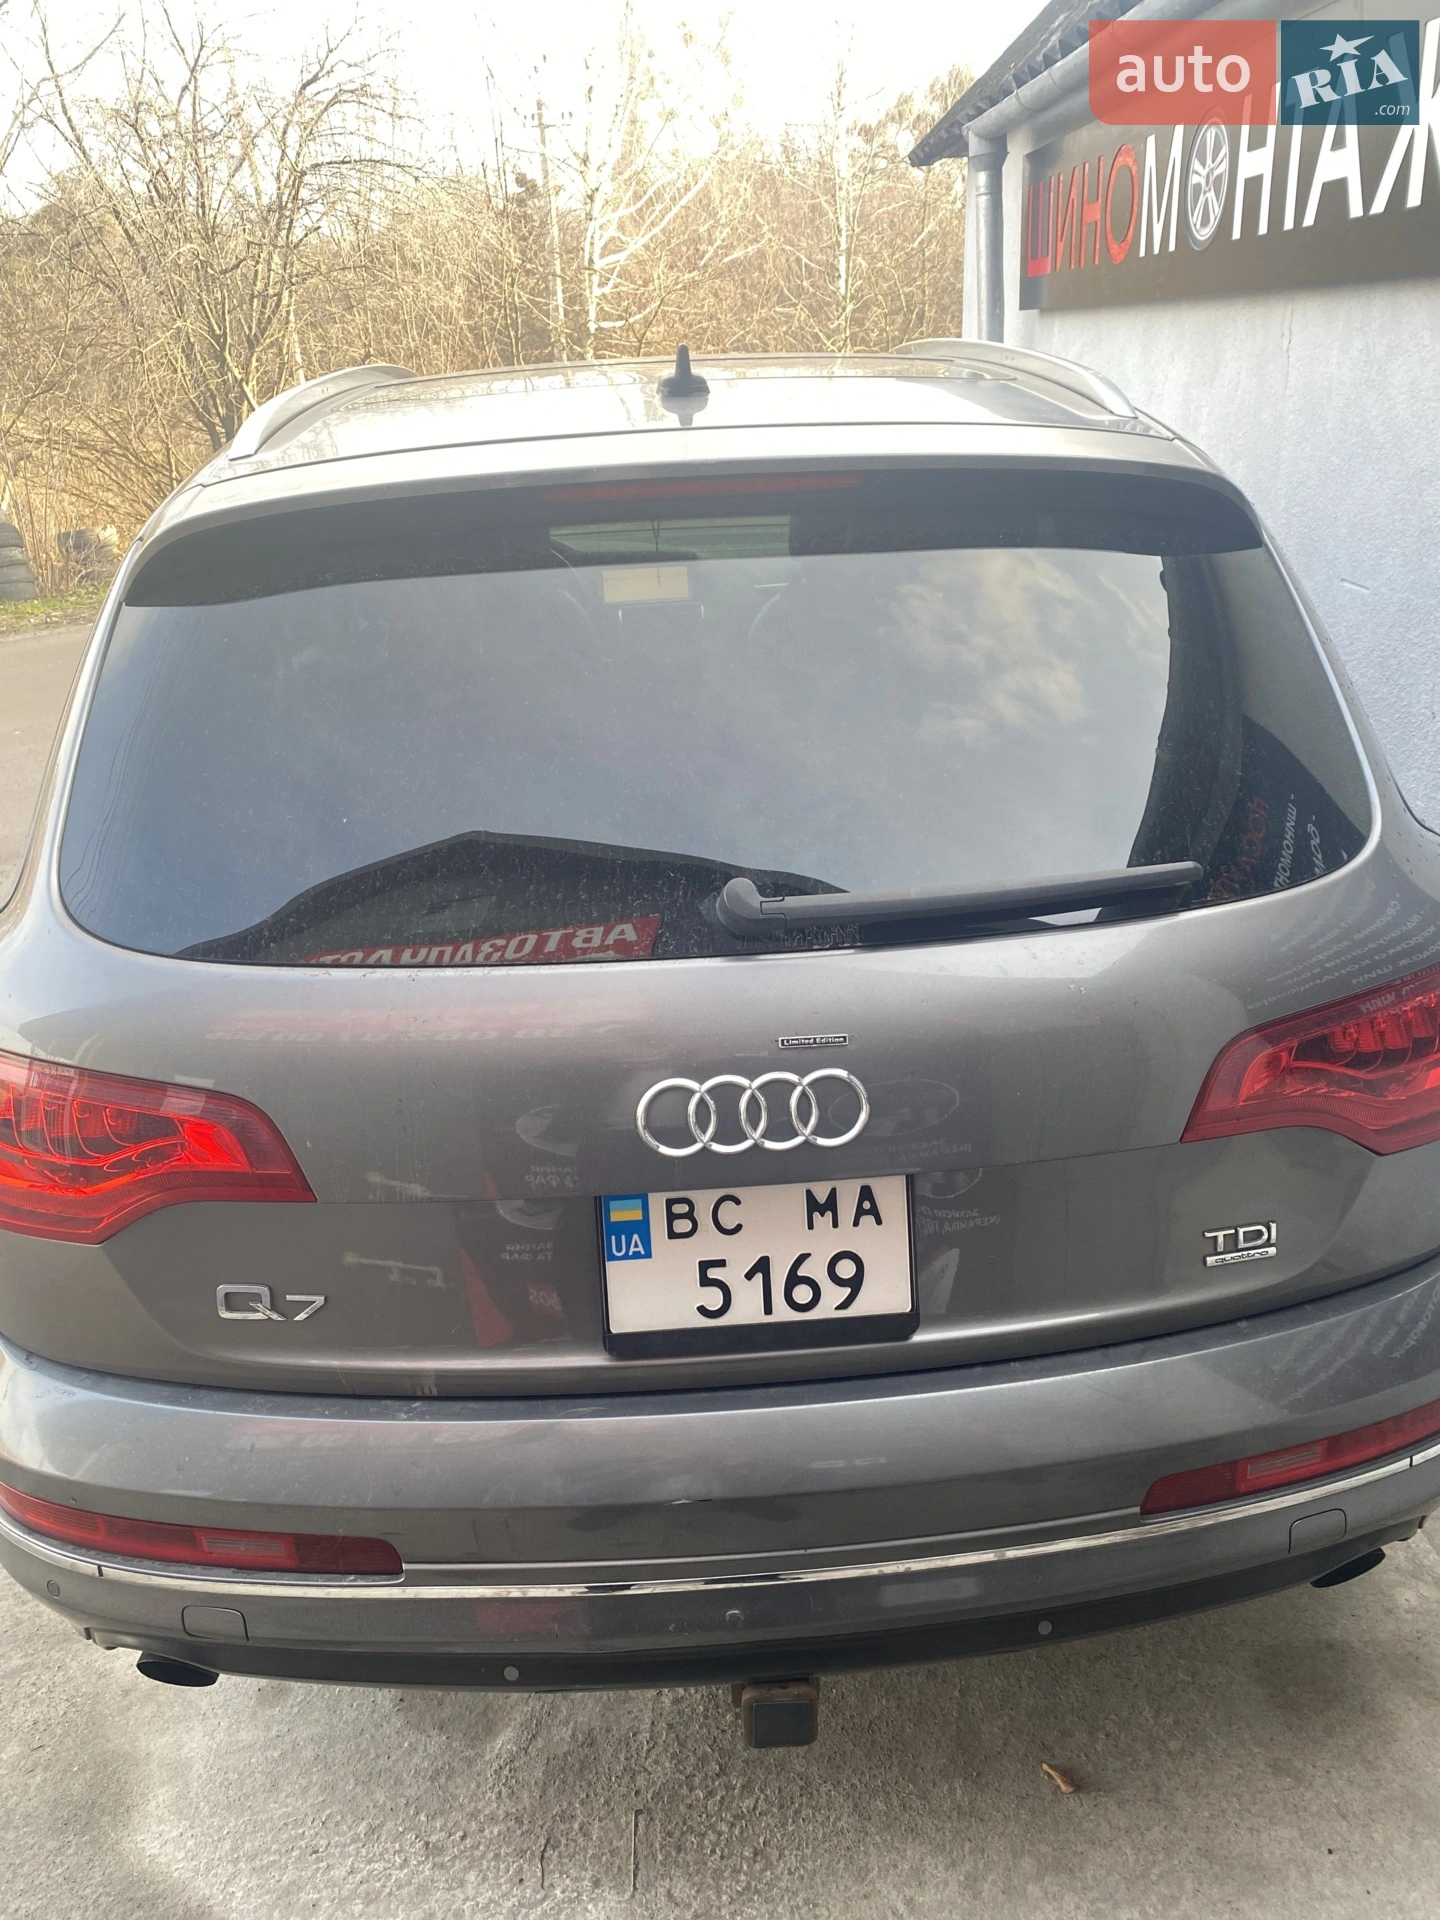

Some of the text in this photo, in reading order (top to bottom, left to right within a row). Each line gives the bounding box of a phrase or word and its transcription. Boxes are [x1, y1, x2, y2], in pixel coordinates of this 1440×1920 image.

[783, 1036, 845, 1046] Limited Edition
[610, 1234, 646, 1257] UA
[1204, 1221, 1277, 1253] TDI
[1214, 1250, 1270, 1264] quattro
[695, 1249, 865, 1320] 5169
[215, 1283, 326, 1321] Q7
